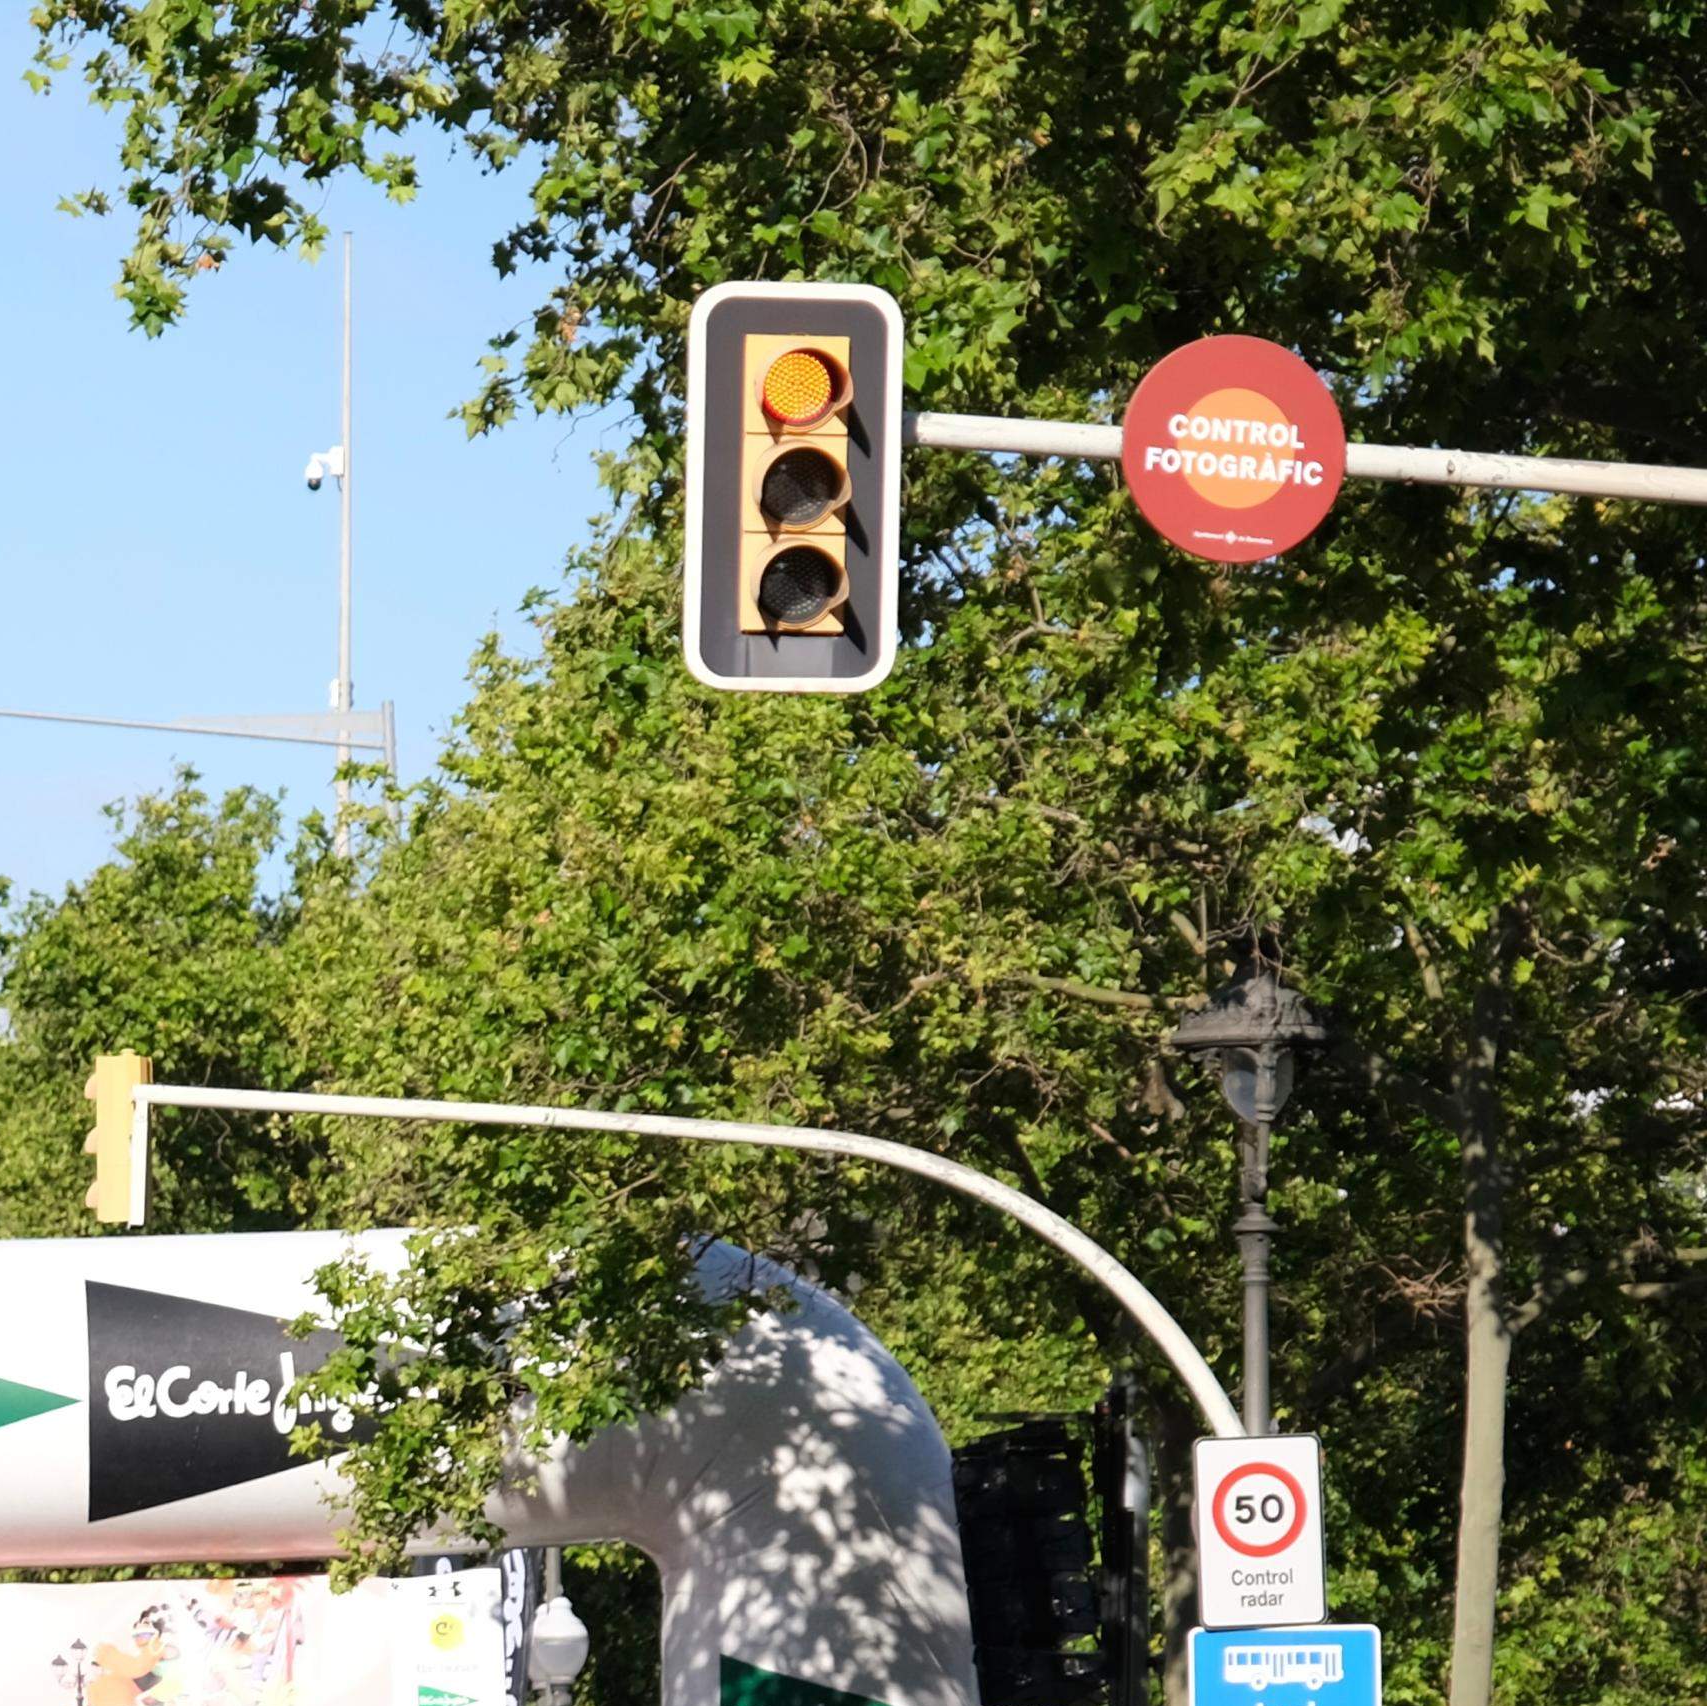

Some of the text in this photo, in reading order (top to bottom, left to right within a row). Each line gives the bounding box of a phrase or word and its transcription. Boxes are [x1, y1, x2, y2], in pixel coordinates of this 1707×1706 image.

[1168, 414, 1305, 449] CONTROL
[1145, 446, 1323, 486] FOTOGRÀFIC
[105, 1364, 155, 1419] El
[155, 1366, 271, 1419] Corte
[1235, 1494, 1284, 1524] 50
[1231, 1567, 1294, 1587] Control
[1240, 1592, 1285, 1608] radar
